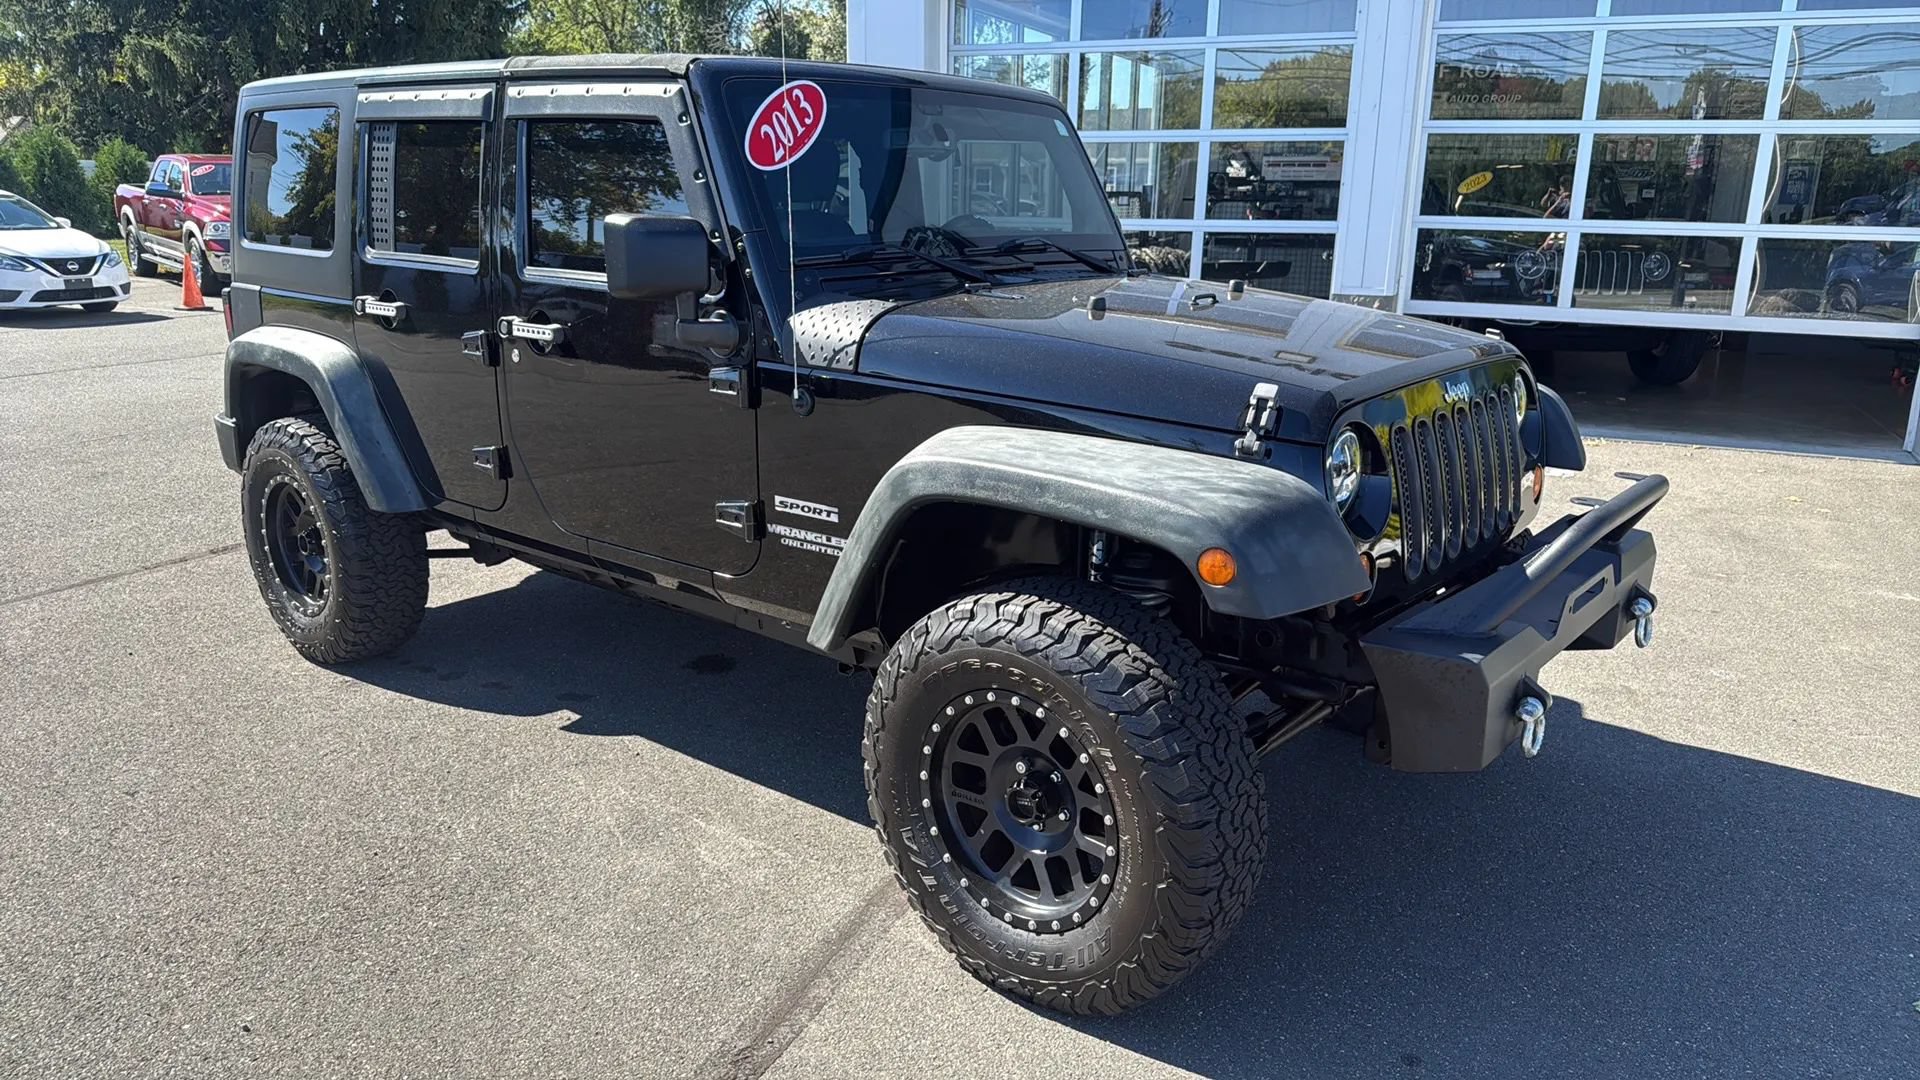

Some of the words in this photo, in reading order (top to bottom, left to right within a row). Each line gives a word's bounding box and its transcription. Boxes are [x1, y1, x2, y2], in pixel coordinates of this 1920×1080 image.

[1448, 94, 1480, 105] AUTO
[1481, 93, 1522, 104] GROUP
[760, 88, 814, 163] 2013
[1464, 173, 1488, 192] 2023
[1444, 381, 1470, 403] Jeep
[775, 500, 839, 519] SPORT
[780, 538, 841, 557] UNLIMITED
